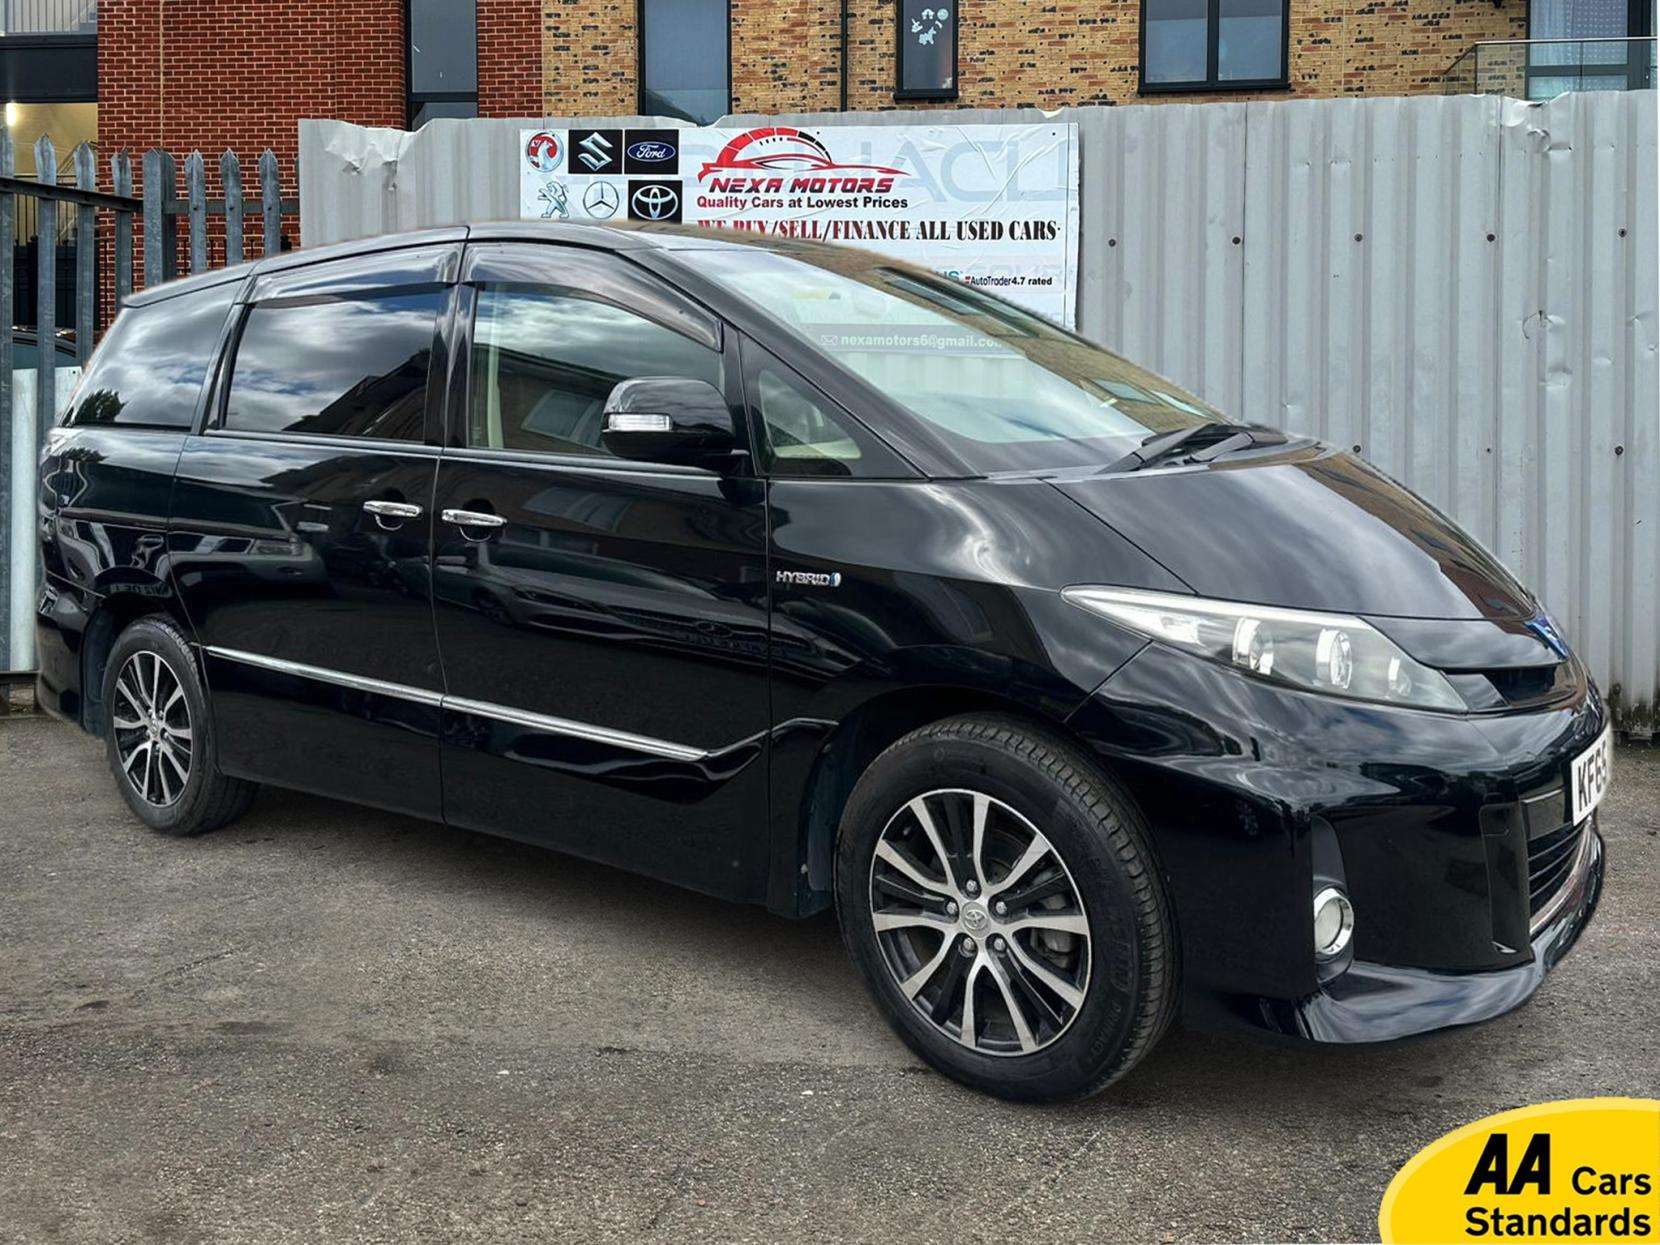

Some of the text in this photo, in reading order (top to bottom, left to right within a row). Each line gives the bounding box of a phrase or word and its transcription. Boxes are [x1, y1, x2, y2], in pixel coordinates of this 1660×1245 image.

[636, 143, 666, 158] Ford
[709, 178, 894, 193] NEXA MOTORS
[697, 195, 908, 210] Quality Cars at Lowest Prices
[916, 220, 950, 240] ALL
[957, 220, 1004, 240] USED
[1028, 276, 1053, 286] rated
[776, 570, 831, 586] HYBRID
